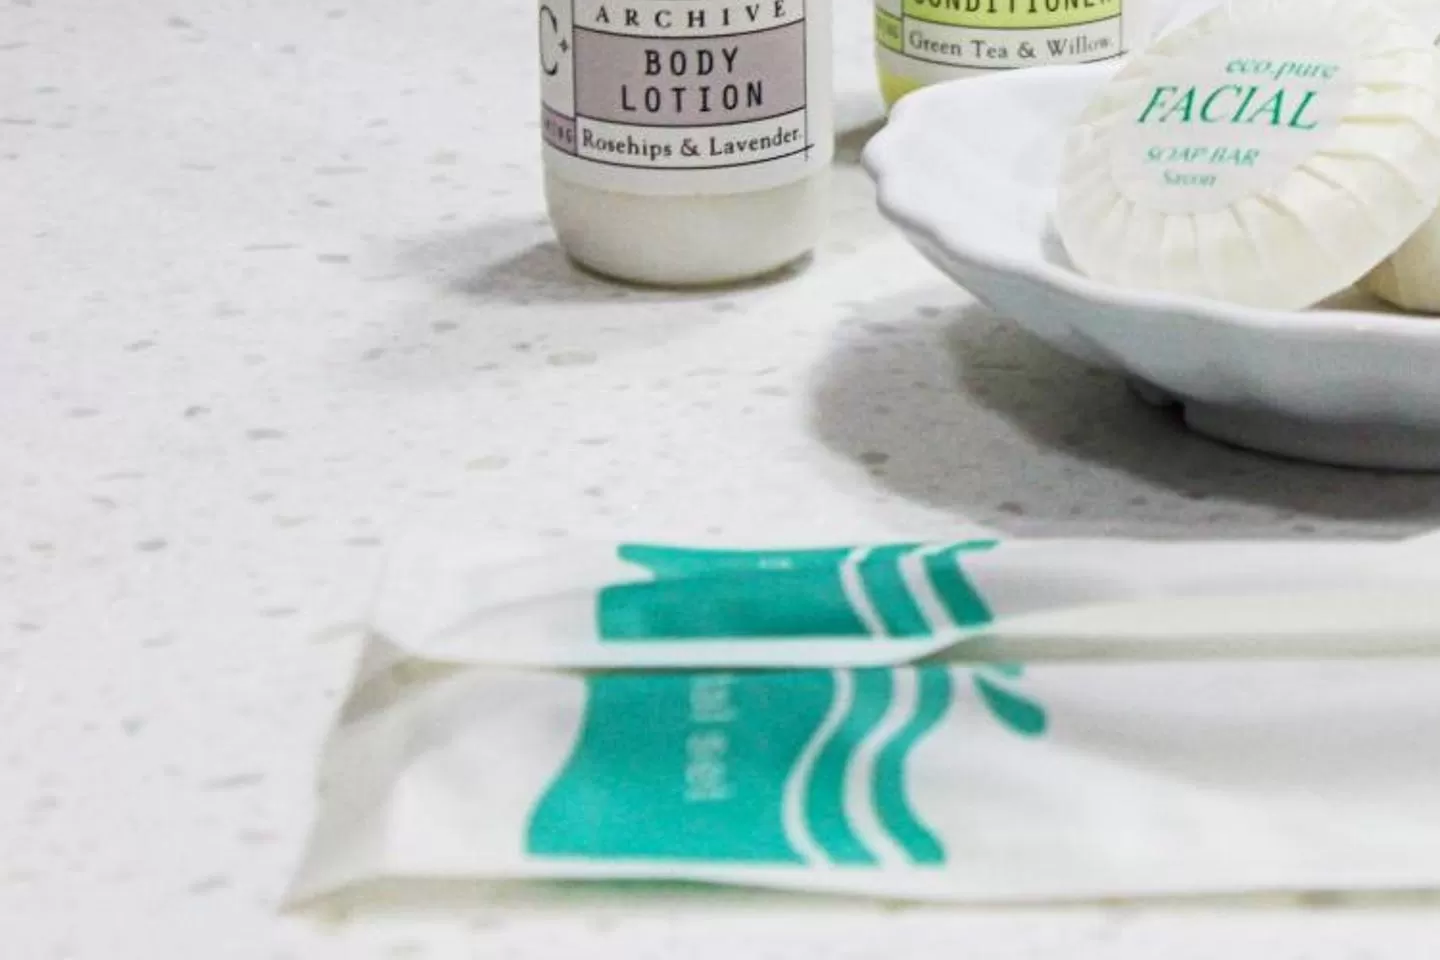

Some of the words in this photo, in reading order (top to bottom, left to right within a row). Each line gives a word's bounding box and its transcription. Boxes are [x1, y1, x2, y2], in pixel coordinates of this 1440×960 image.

[909, 29, 962, 55] Green
[970, 40, 1007, 59] Tea
[1016, 41, 1037, 60] &
[644, 46, 739, 76] BODY
[1224, 58, 1341, 82] eco.pure
[620, 80, 764, 113] LOTION
[1136, 83, 1320, 131] FACIAL
[582, 128, 673, 161] Rosehips
[679, 140, 701, 158] &
[1208, 146, 1261, 168] BAR
